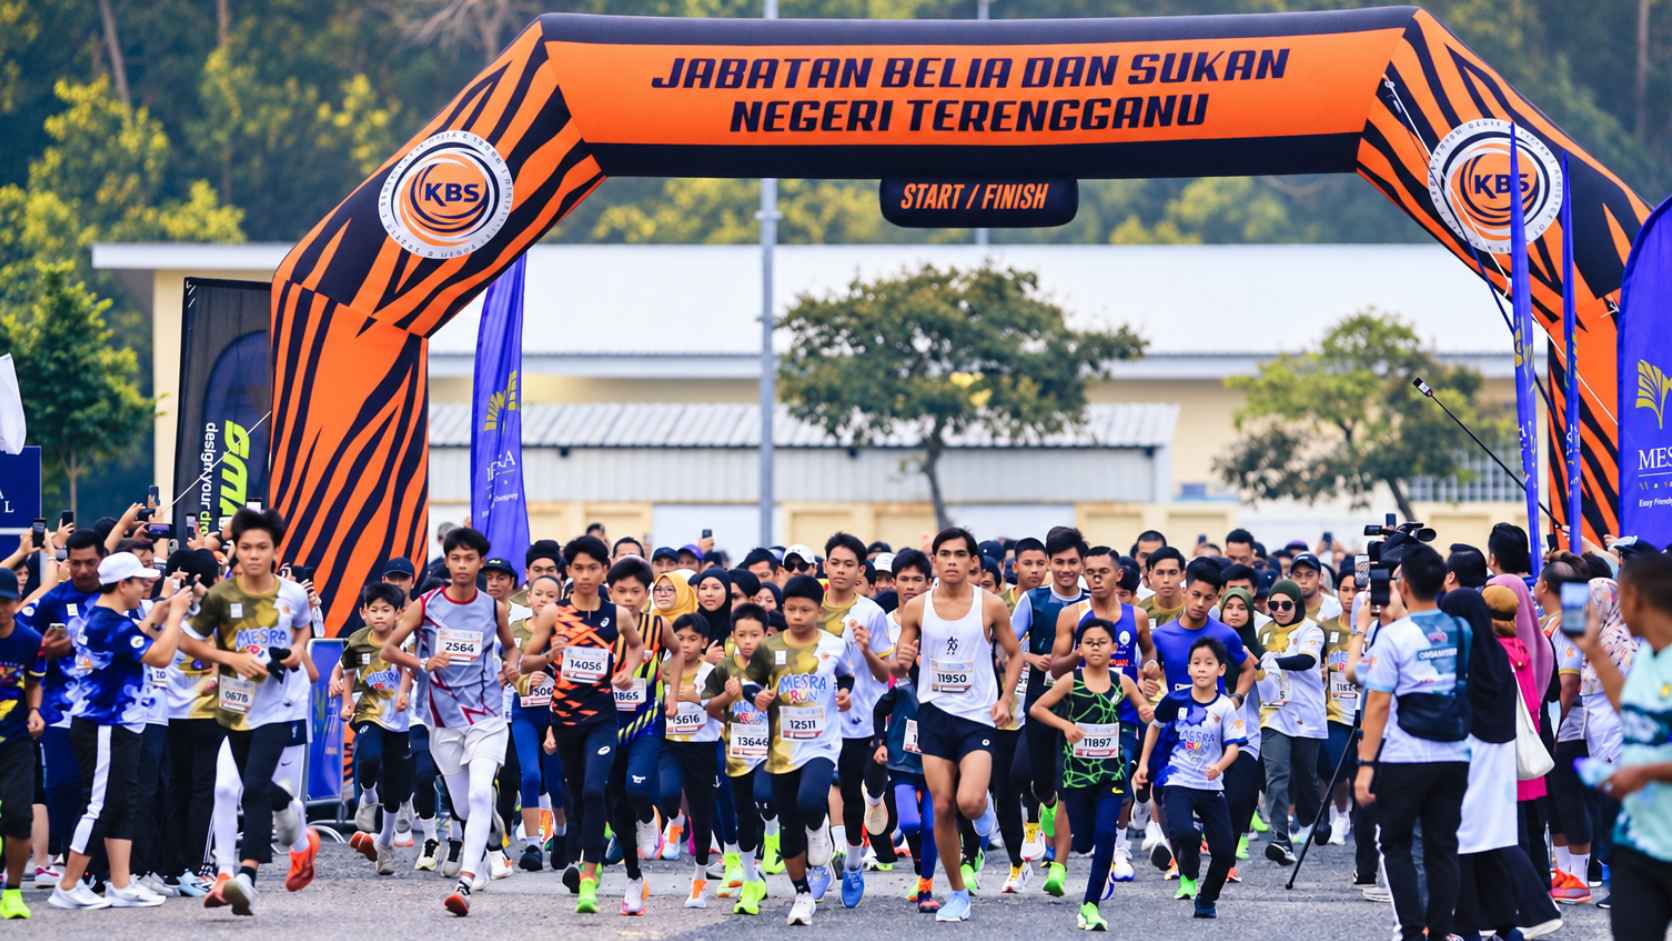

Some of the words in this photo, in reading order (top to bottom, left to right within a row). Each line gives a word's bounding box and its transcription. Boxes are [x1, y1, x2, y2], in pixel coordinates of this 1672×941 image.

[651, 57, 874, 89] JABATAN
[880, 57, 1013, 89] BELIA
[1020, 55, 1120, 89] DAN
[1127, 48, 1290, 85] SUKAN
[729, 100, 893, 132] NEGERI
[906, 93, 1209, 132] TERENGGANU
[424, 183, 480, 207] KBS
[900, 183, 966, 209] START
[965, 183, 981, 210] /
[981, 182, 1049, 210] FINISH
[199, 473, 212, 510] your
[445, 642, 474, 653] 2564
[570, 659, 602, 671] 14056
[780, 673, 827, 691] MESRA
[937, 673, 967, 683] 11950
[789, 719, 816, 730] 12511
[737, 736, 769, 747] 13646
[1084, 737, 1112, 748] 11897
